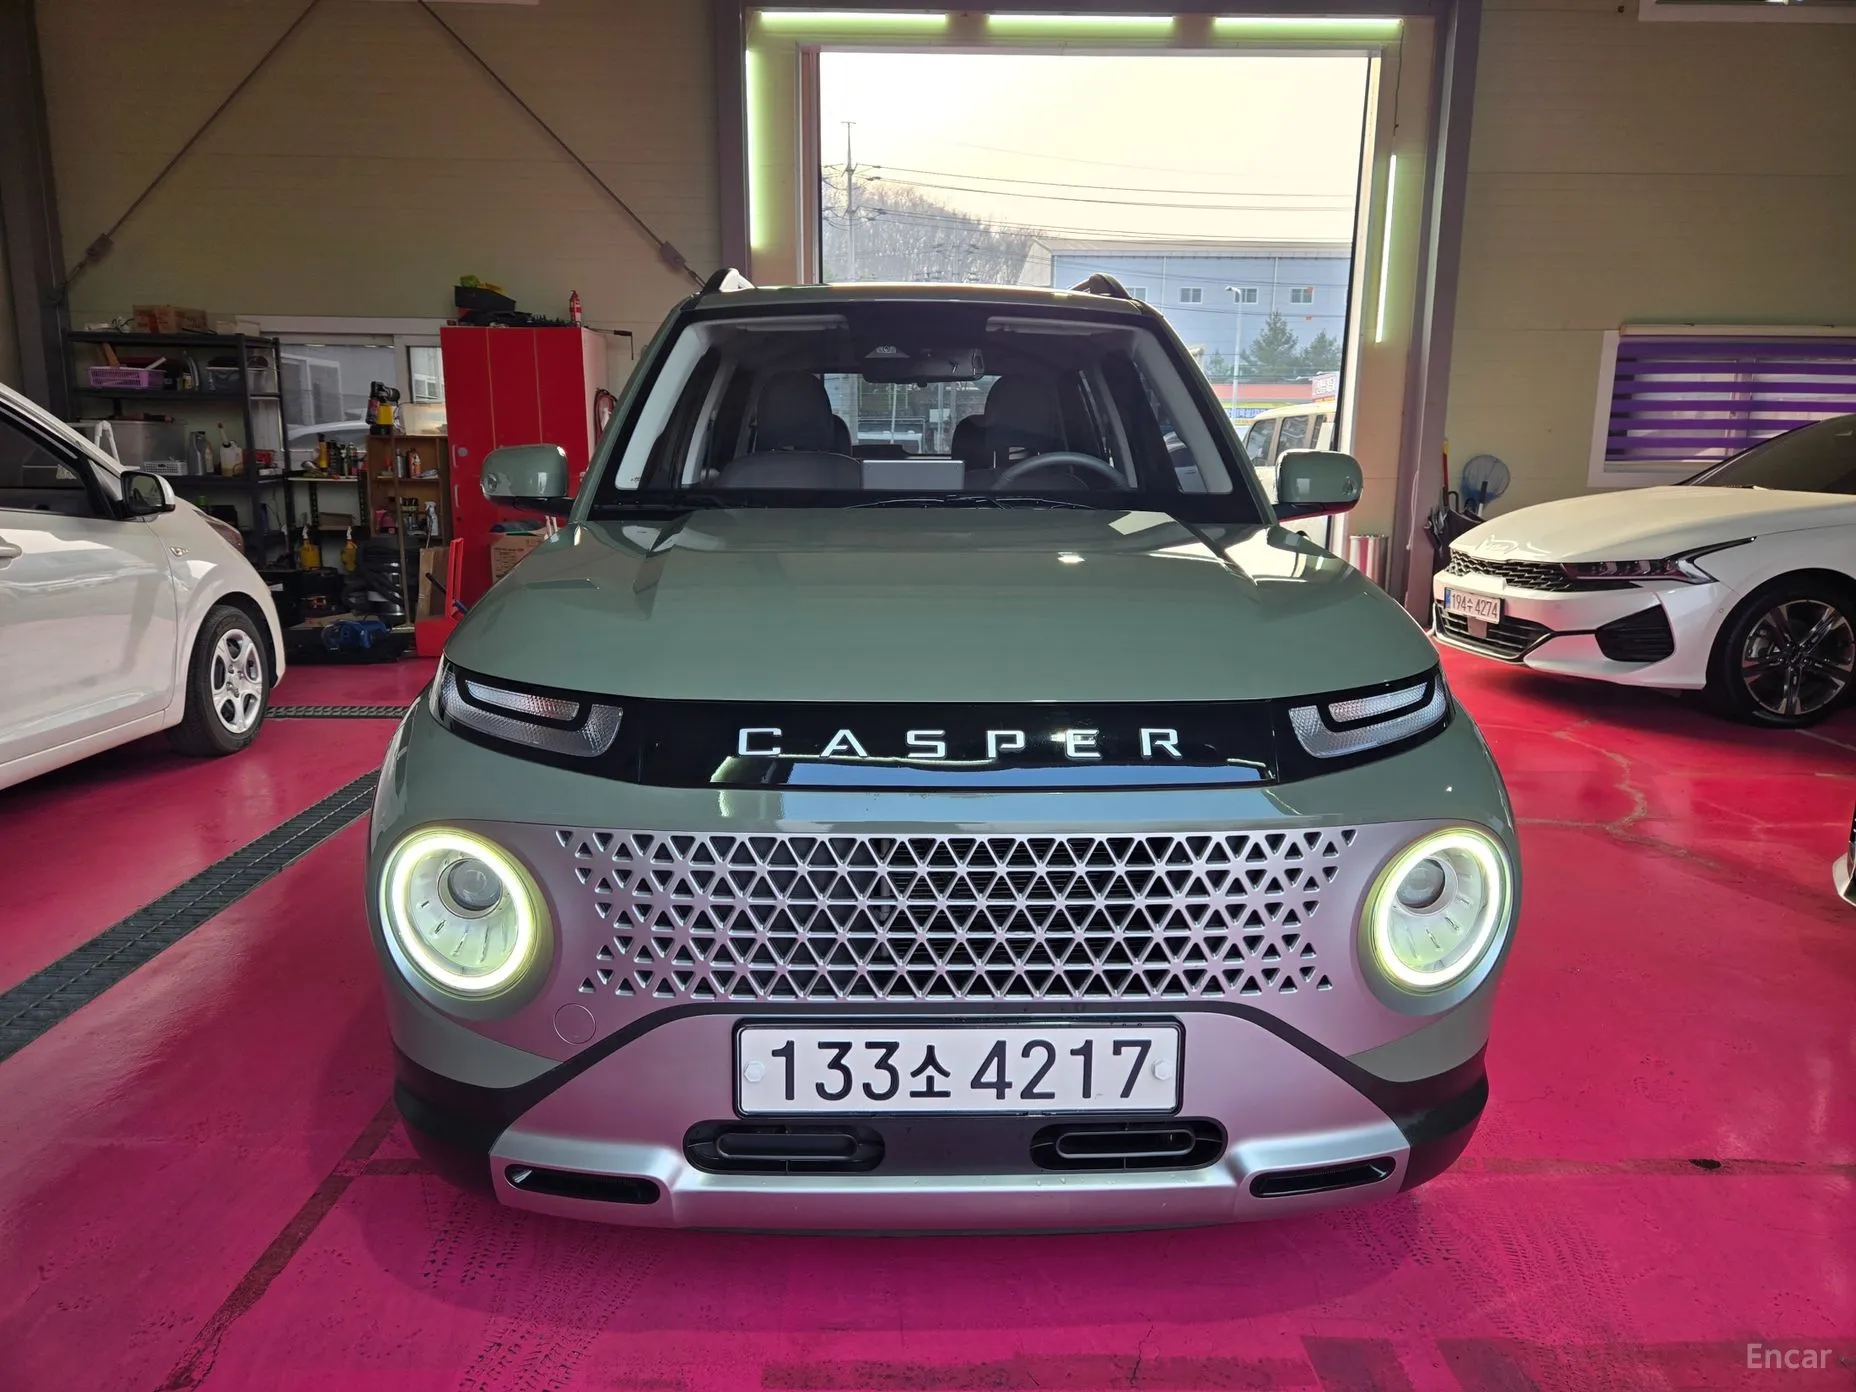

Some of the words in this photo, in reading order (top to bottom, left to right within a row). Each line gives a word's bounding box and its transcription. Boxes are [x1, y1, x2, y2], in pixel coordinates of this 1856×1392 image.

[1452, 593, 1473, 612] 194수
[1475, 599, 1498, 618] 4274
[738, 727, 1182, 759] CASPER
[771, 1039, 951, 1101] 133소
[970, 1039, 1152, 1101] 4217
